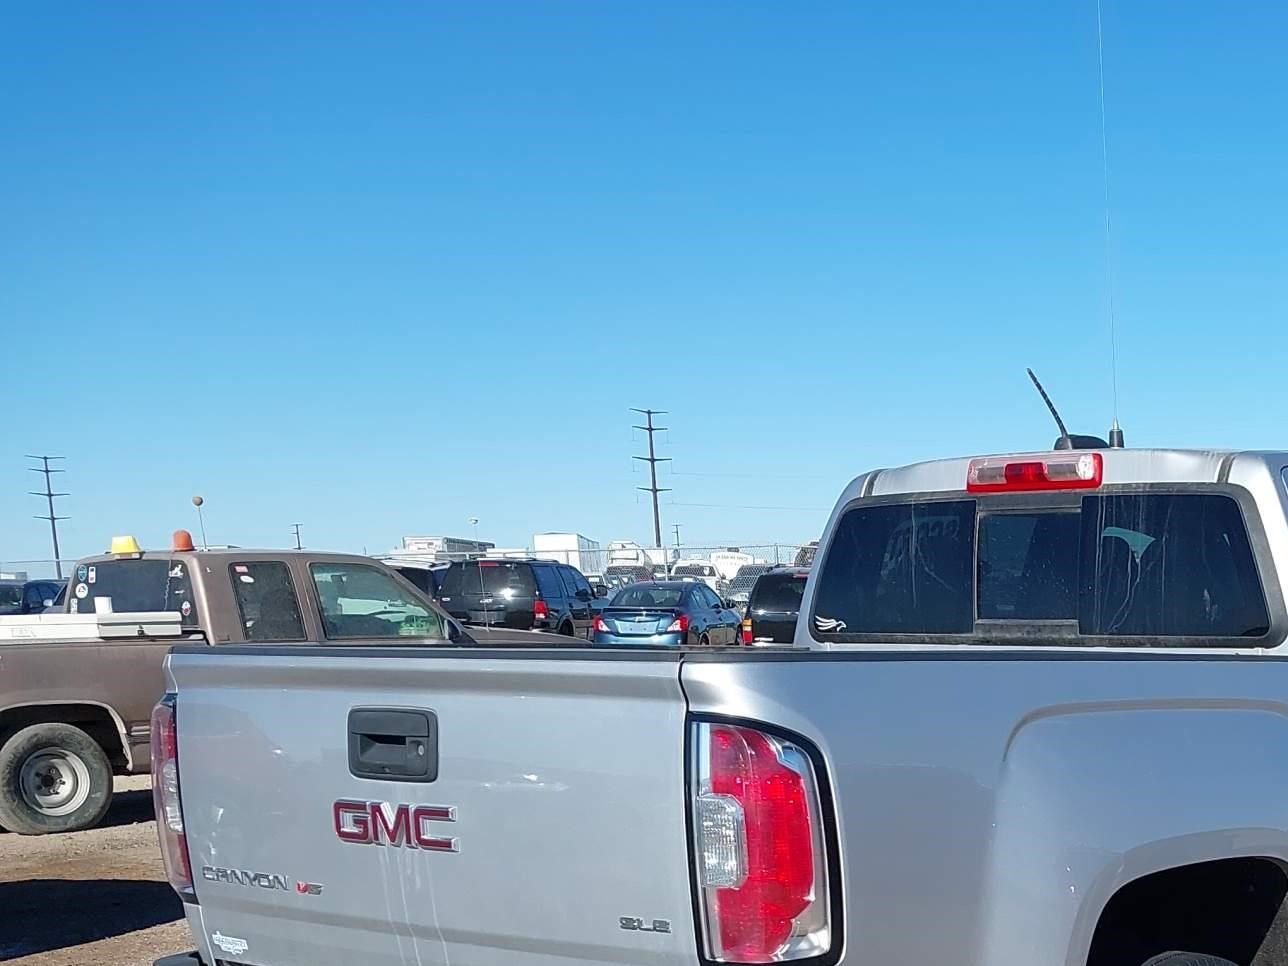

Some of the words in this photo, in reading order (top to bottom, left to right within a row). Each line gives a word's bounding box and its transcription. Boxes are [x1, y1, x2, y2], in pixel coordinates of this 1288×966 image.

[332, 798, 460, 852] GMC
[203, 866, 290, 891] CANYON
[620, 916, 671, 933] SLE
